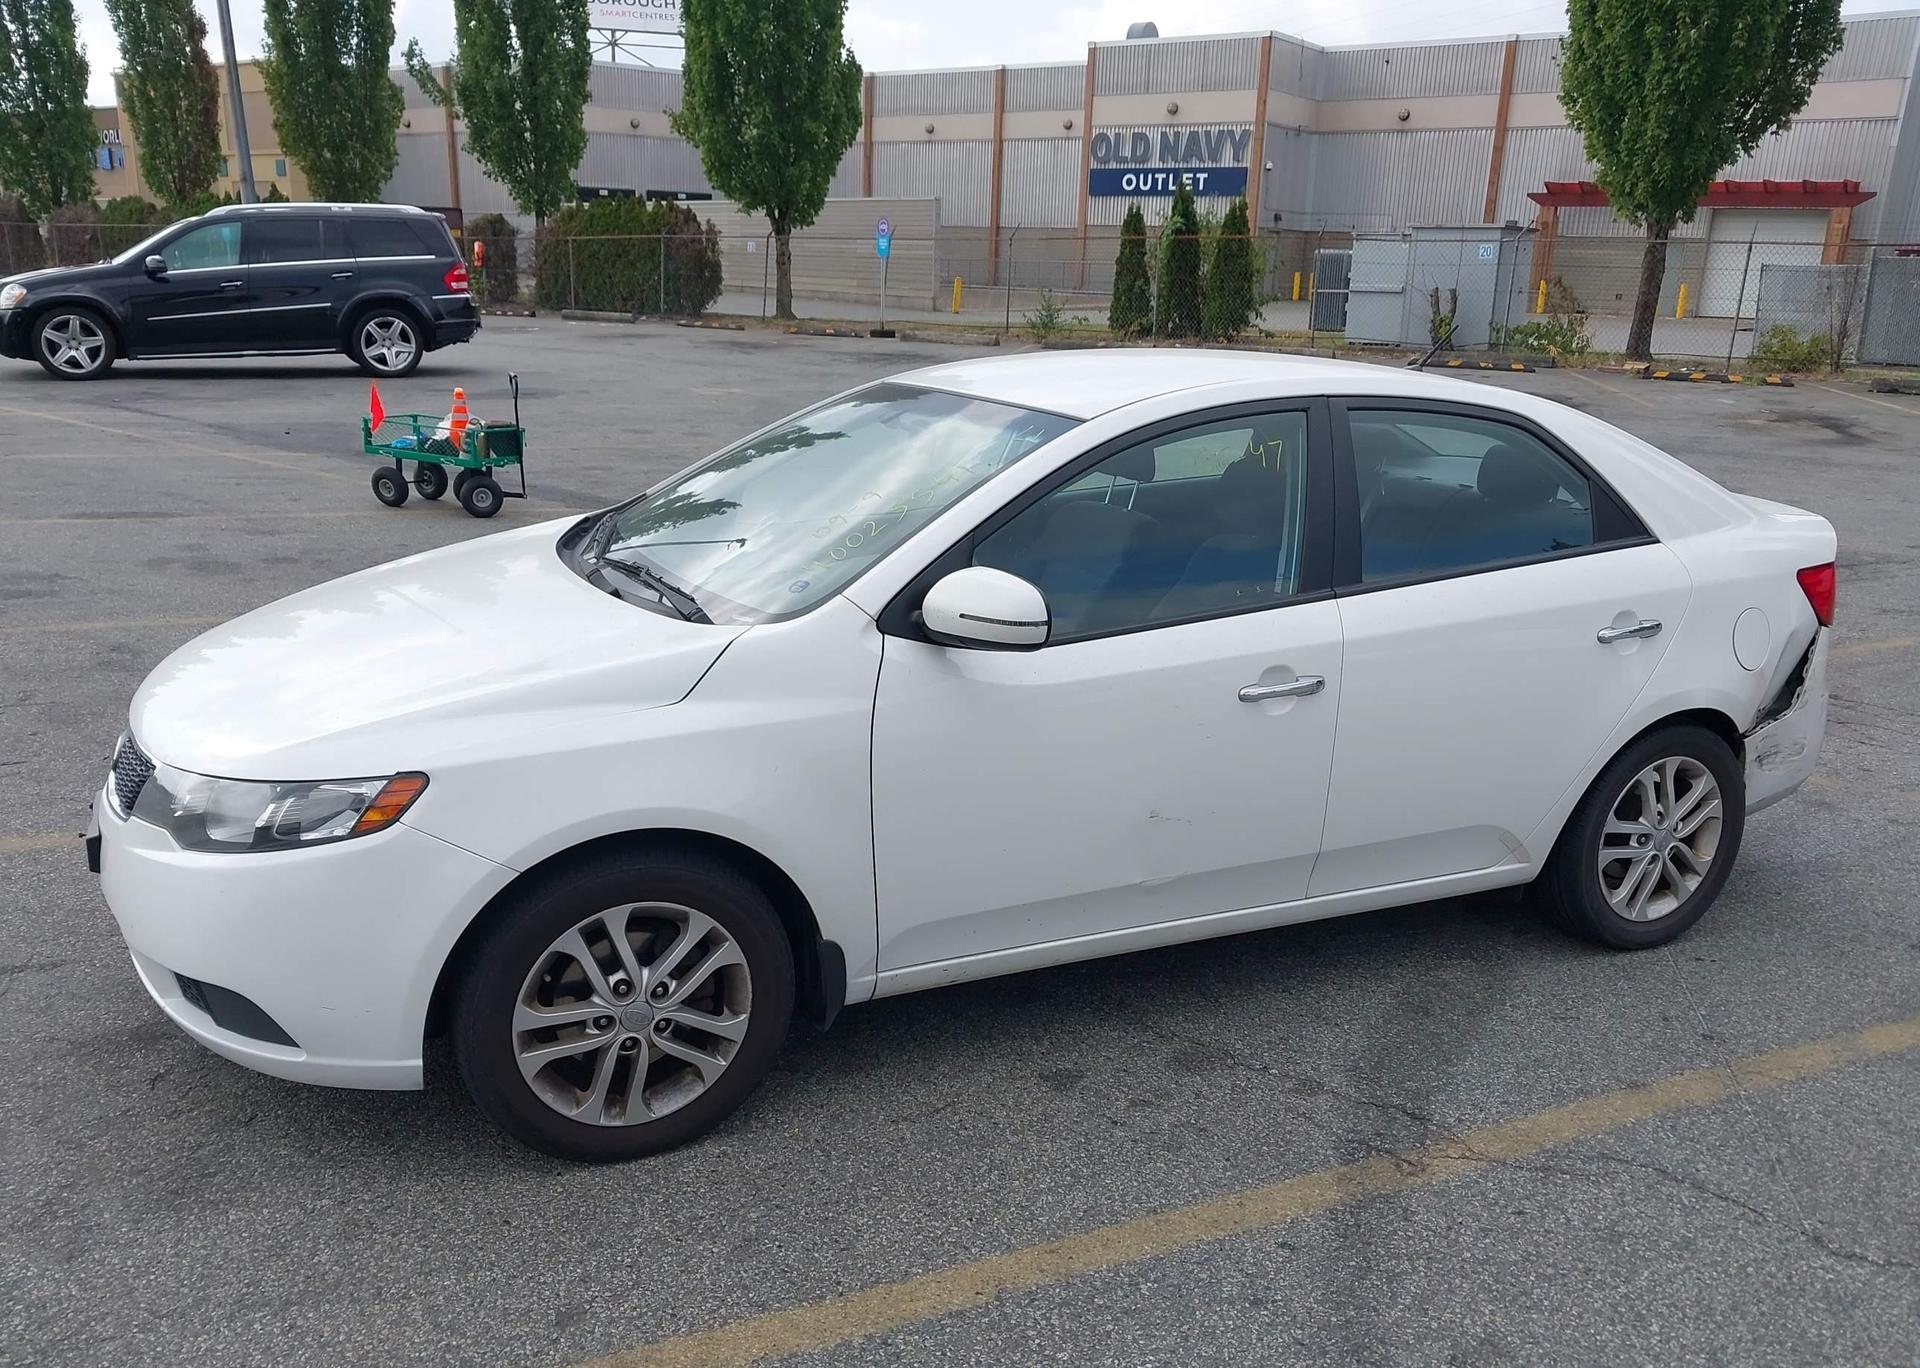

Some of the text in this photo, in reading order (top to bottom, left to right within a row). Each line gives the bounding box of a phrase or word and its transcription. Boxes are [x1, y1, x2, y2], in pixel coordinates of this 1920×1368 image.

[599, 9, 676, 21] SMARTCENTRES
[1091, 129, 1252, 164] OLD NAVY
[1121, 172, 1209, 191] OUTLET
[1480, 245, 1492, 257] 20
